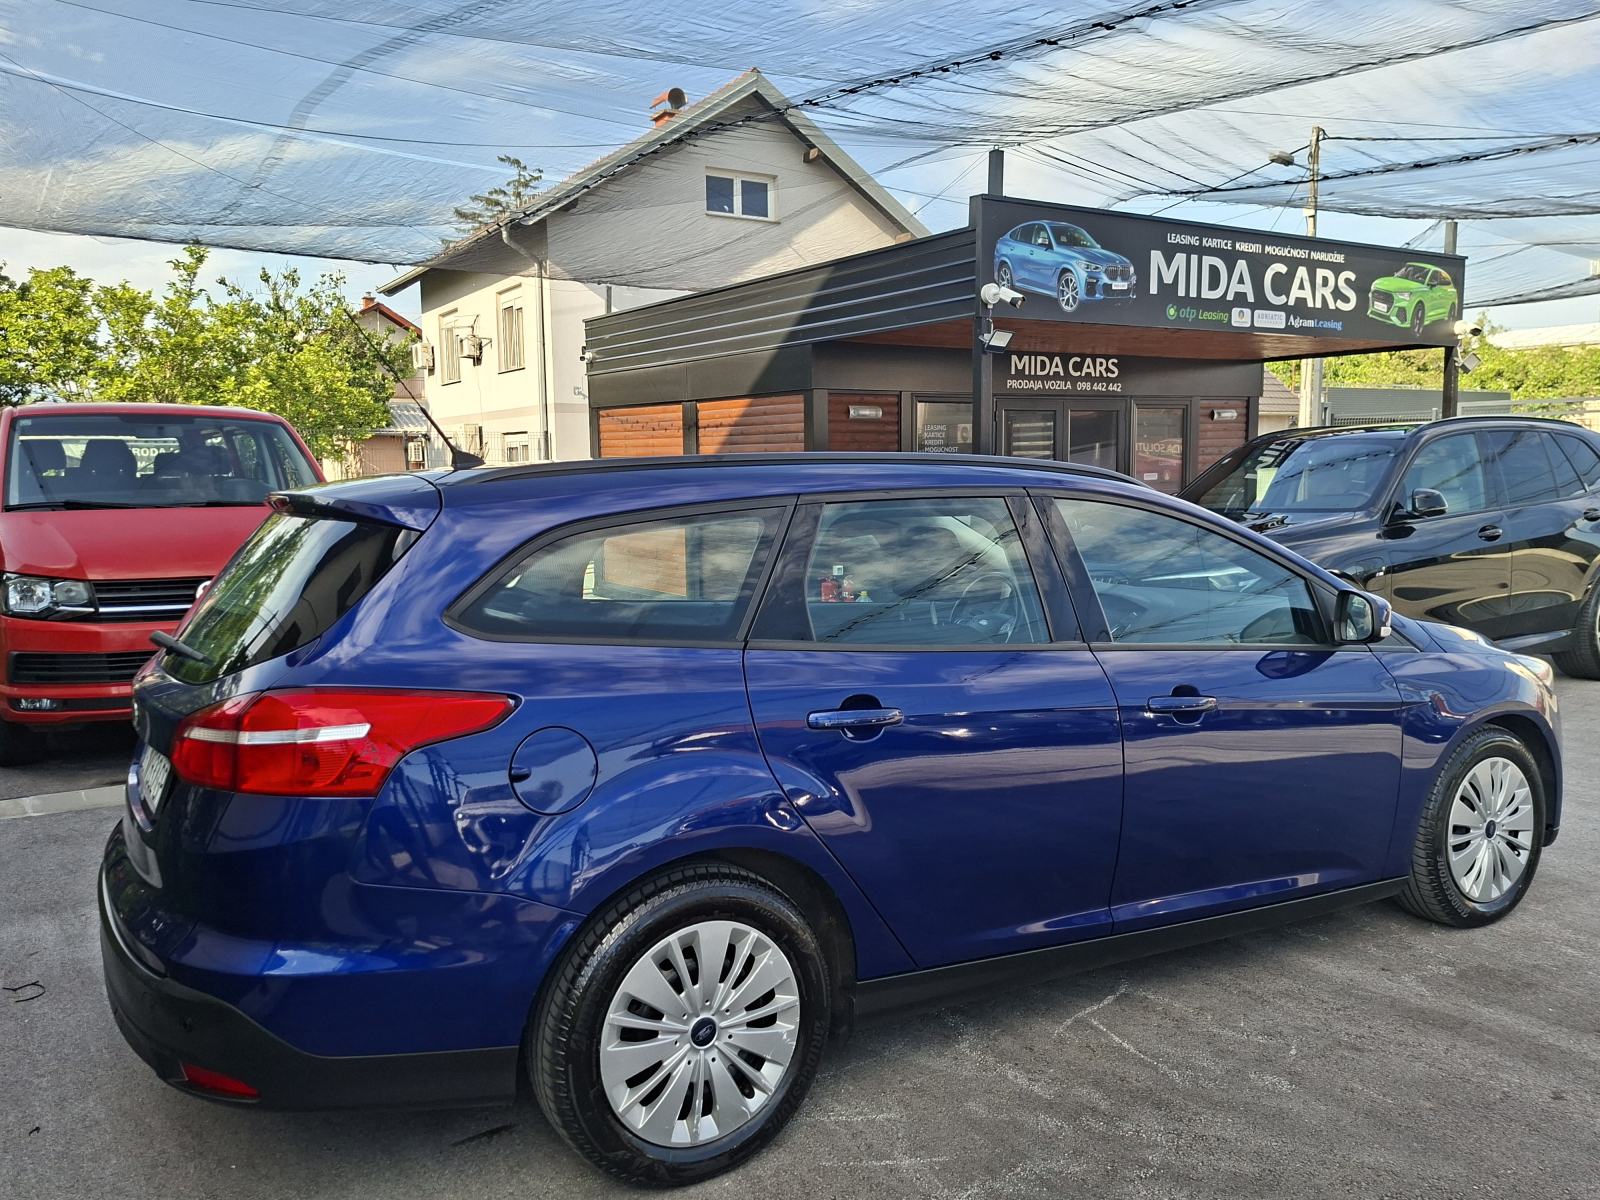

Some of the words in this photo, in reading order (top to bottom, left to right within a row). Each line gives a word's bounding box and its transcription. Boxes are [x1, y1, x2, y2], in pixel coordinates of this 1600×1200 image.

[1167, 232, 1200, 246] LEASING
[1202, 236, 1233, 250] KARTICE
[1235, 241, 1262, 254] KREDITI
[1264, 244, 1309, 259] MOGUĆNOST
[1310, 250, 1346, 263] NARUDŽBE
[1149, 250, 1255, 303] MIDA
[1263, 262, 1358, 312] CARS
[1179, 307, 1197, 322] otp
[1198, 308, 1229, 323] Leasing
[1010, 354, 1065, 377] MIDA
[1068, 356, 1119, 378] CARS
[1006, 379, 1043, 391] PRODAJA
[1044, 380, 1072, 390] VOZILA
[1076, 381, 1091, 391] 098
[1092, 382, 1107, 392] 442
[1107, 382, 1122, 392] 442
